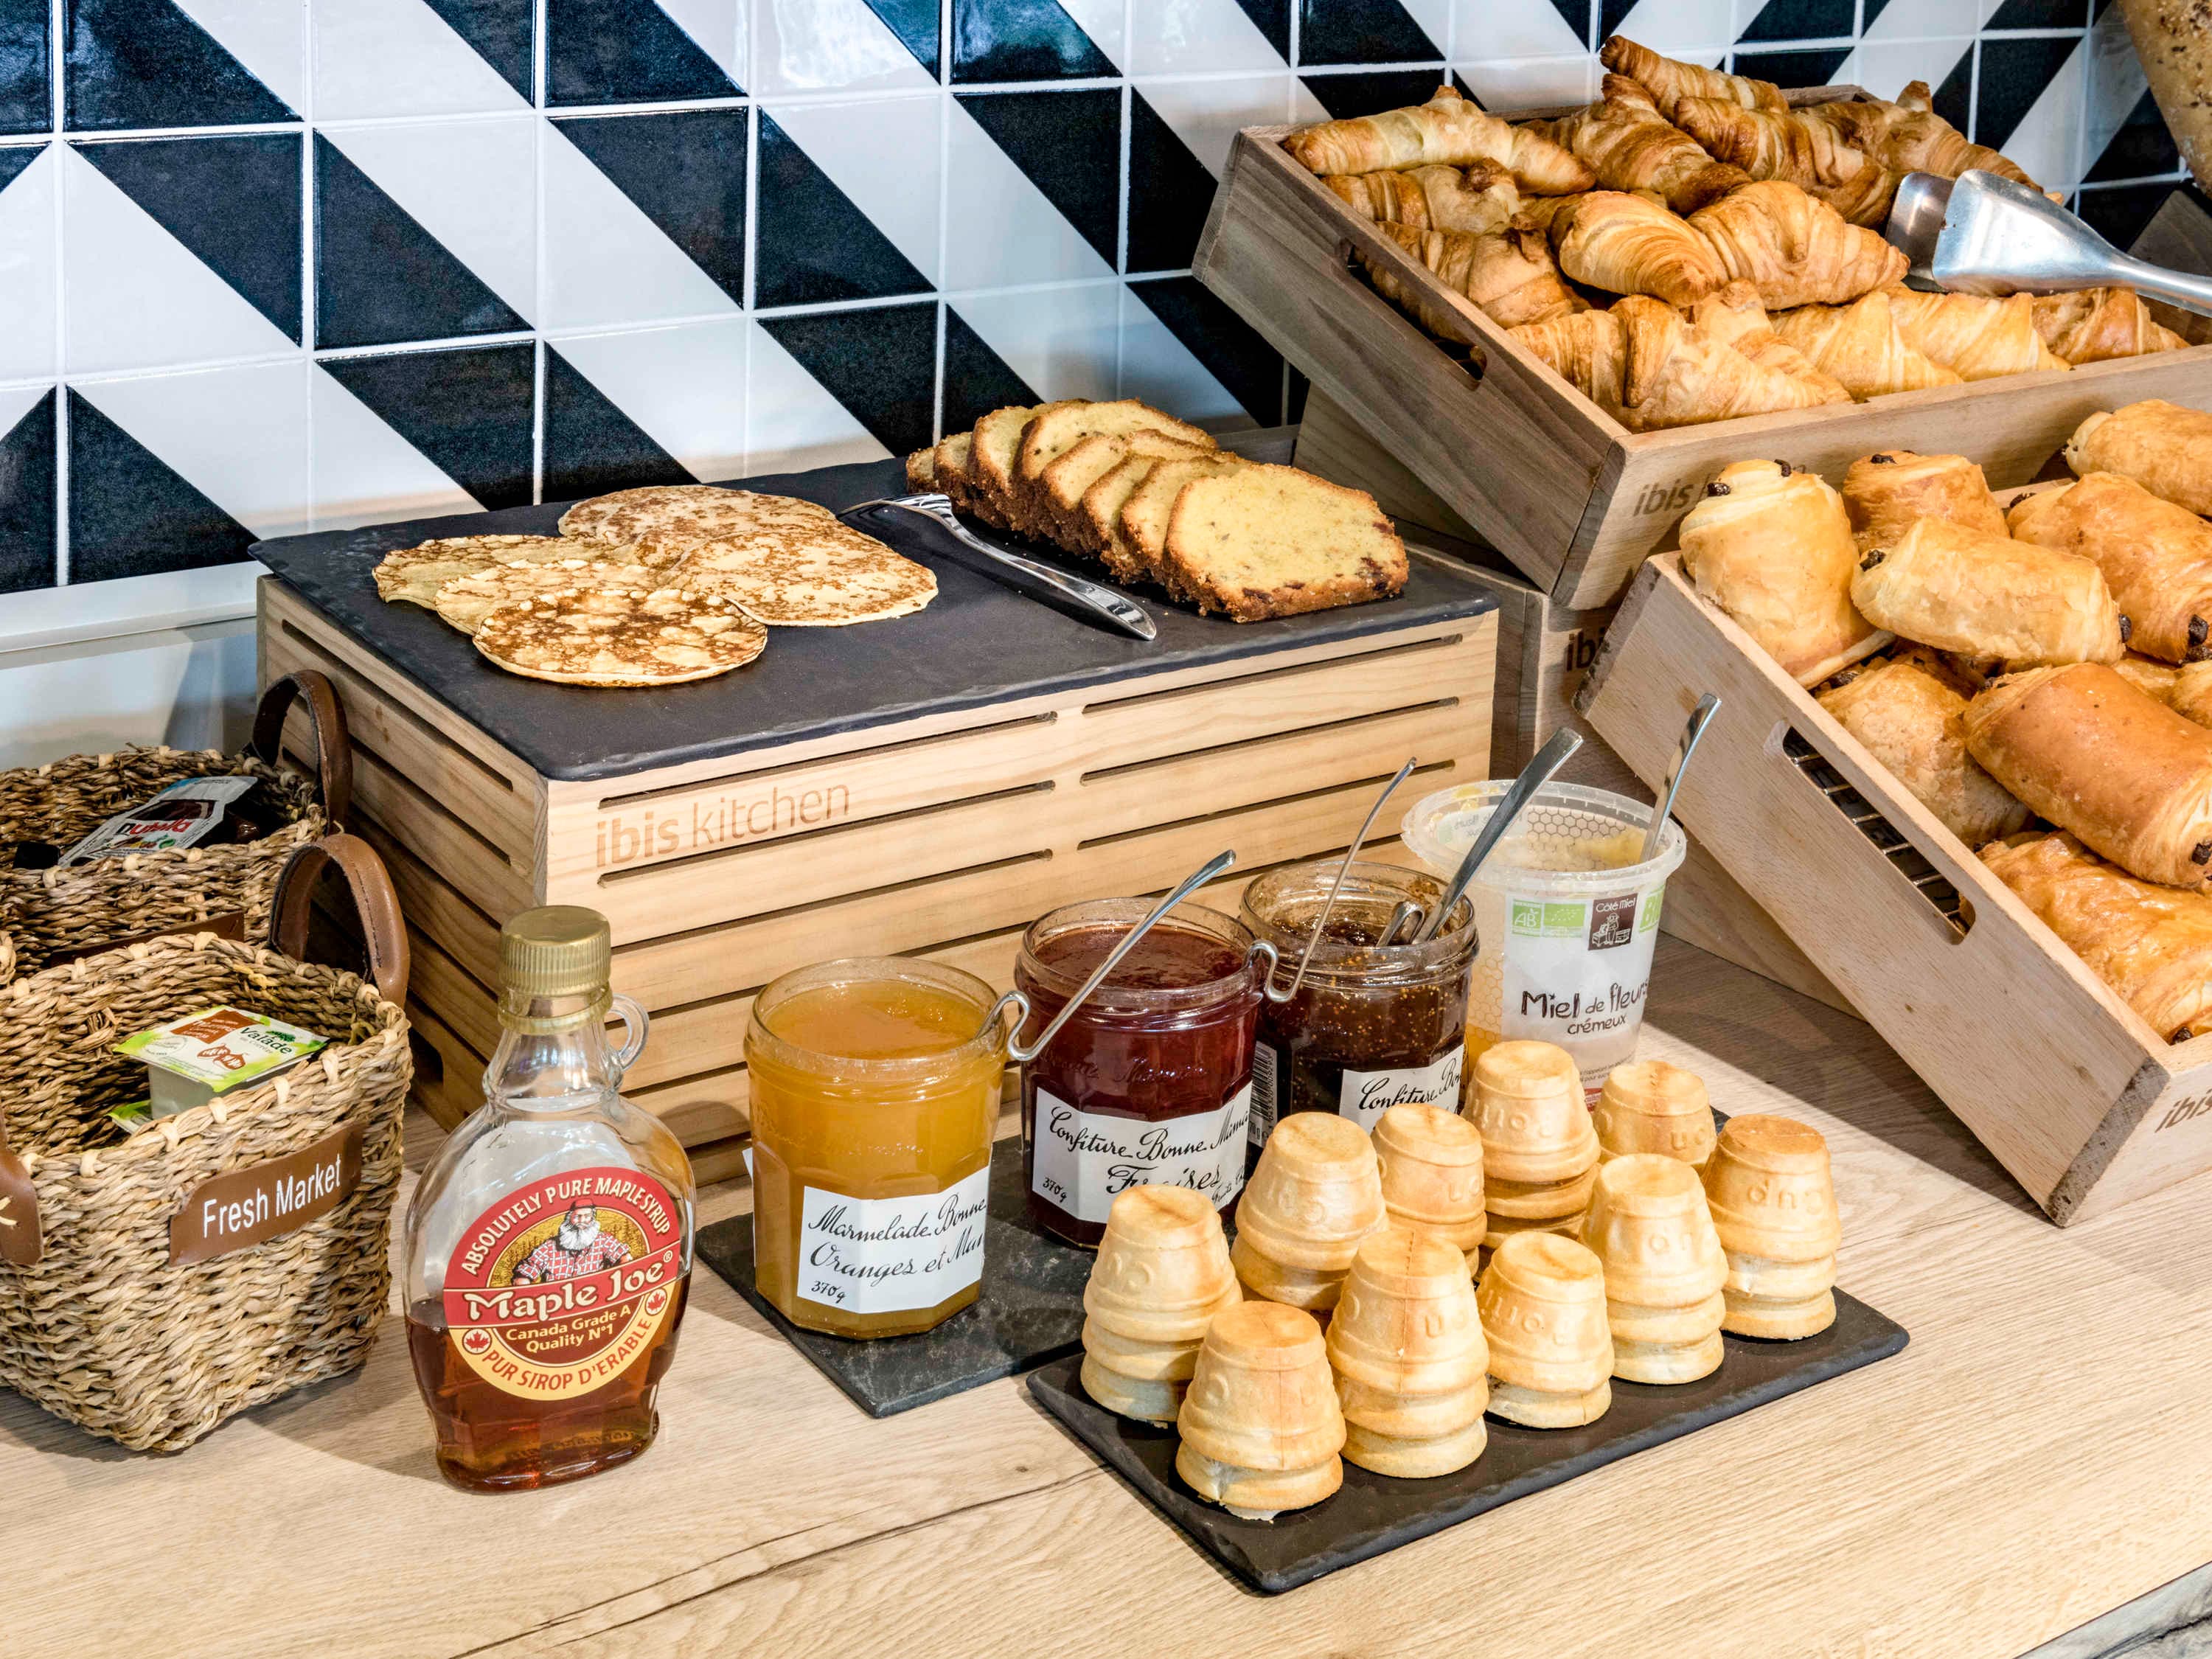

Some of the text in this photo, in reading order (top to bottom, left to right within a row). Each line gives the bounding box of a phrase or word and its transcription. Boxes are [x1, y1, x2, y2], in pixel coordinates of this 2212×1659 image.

[1633, 479, 1694, 516] ibis
[596, 784, 850, 868] ibis kitchen
[1514, 913, 1537, 927] AB
[1618, 897, 1636, 909] Miel
[1520, 990, 1580, 1019] Miel
[1585, 995, 1606, 1015] de
[239, 1027, 293, 1055] Valade
[1568, 1014, 1627, 1036] crémeux
[1359, 1077, 1438, 1110] Confiture
[1049, 1106, 1133, 1161] Confiture
[1136, 1127, 1207, 1163] Bonne
[203, 1152, 342, 1239] Fresh Market
[1042, 1175, 1068, 1204] 370g
[462, 1178, 670, 1276] ABSOLUTELY PURE MAPLE SYRUP
[807, 1192, 987, 1243] Marmelade Bonne
[810, 1240, 917, 1288] Oranges
[924, 1251, 946, 1275] et
[465, 1262, 664, 1322] Maple Joe
[810, 1280, 847, 1304] 370g
[506, 1305, 632, 1343] Canada Grade A
[481, 1318, 651, 1391] PUR SIROP D'ERABLE
[526, 1334, 585, 1355] Quality
